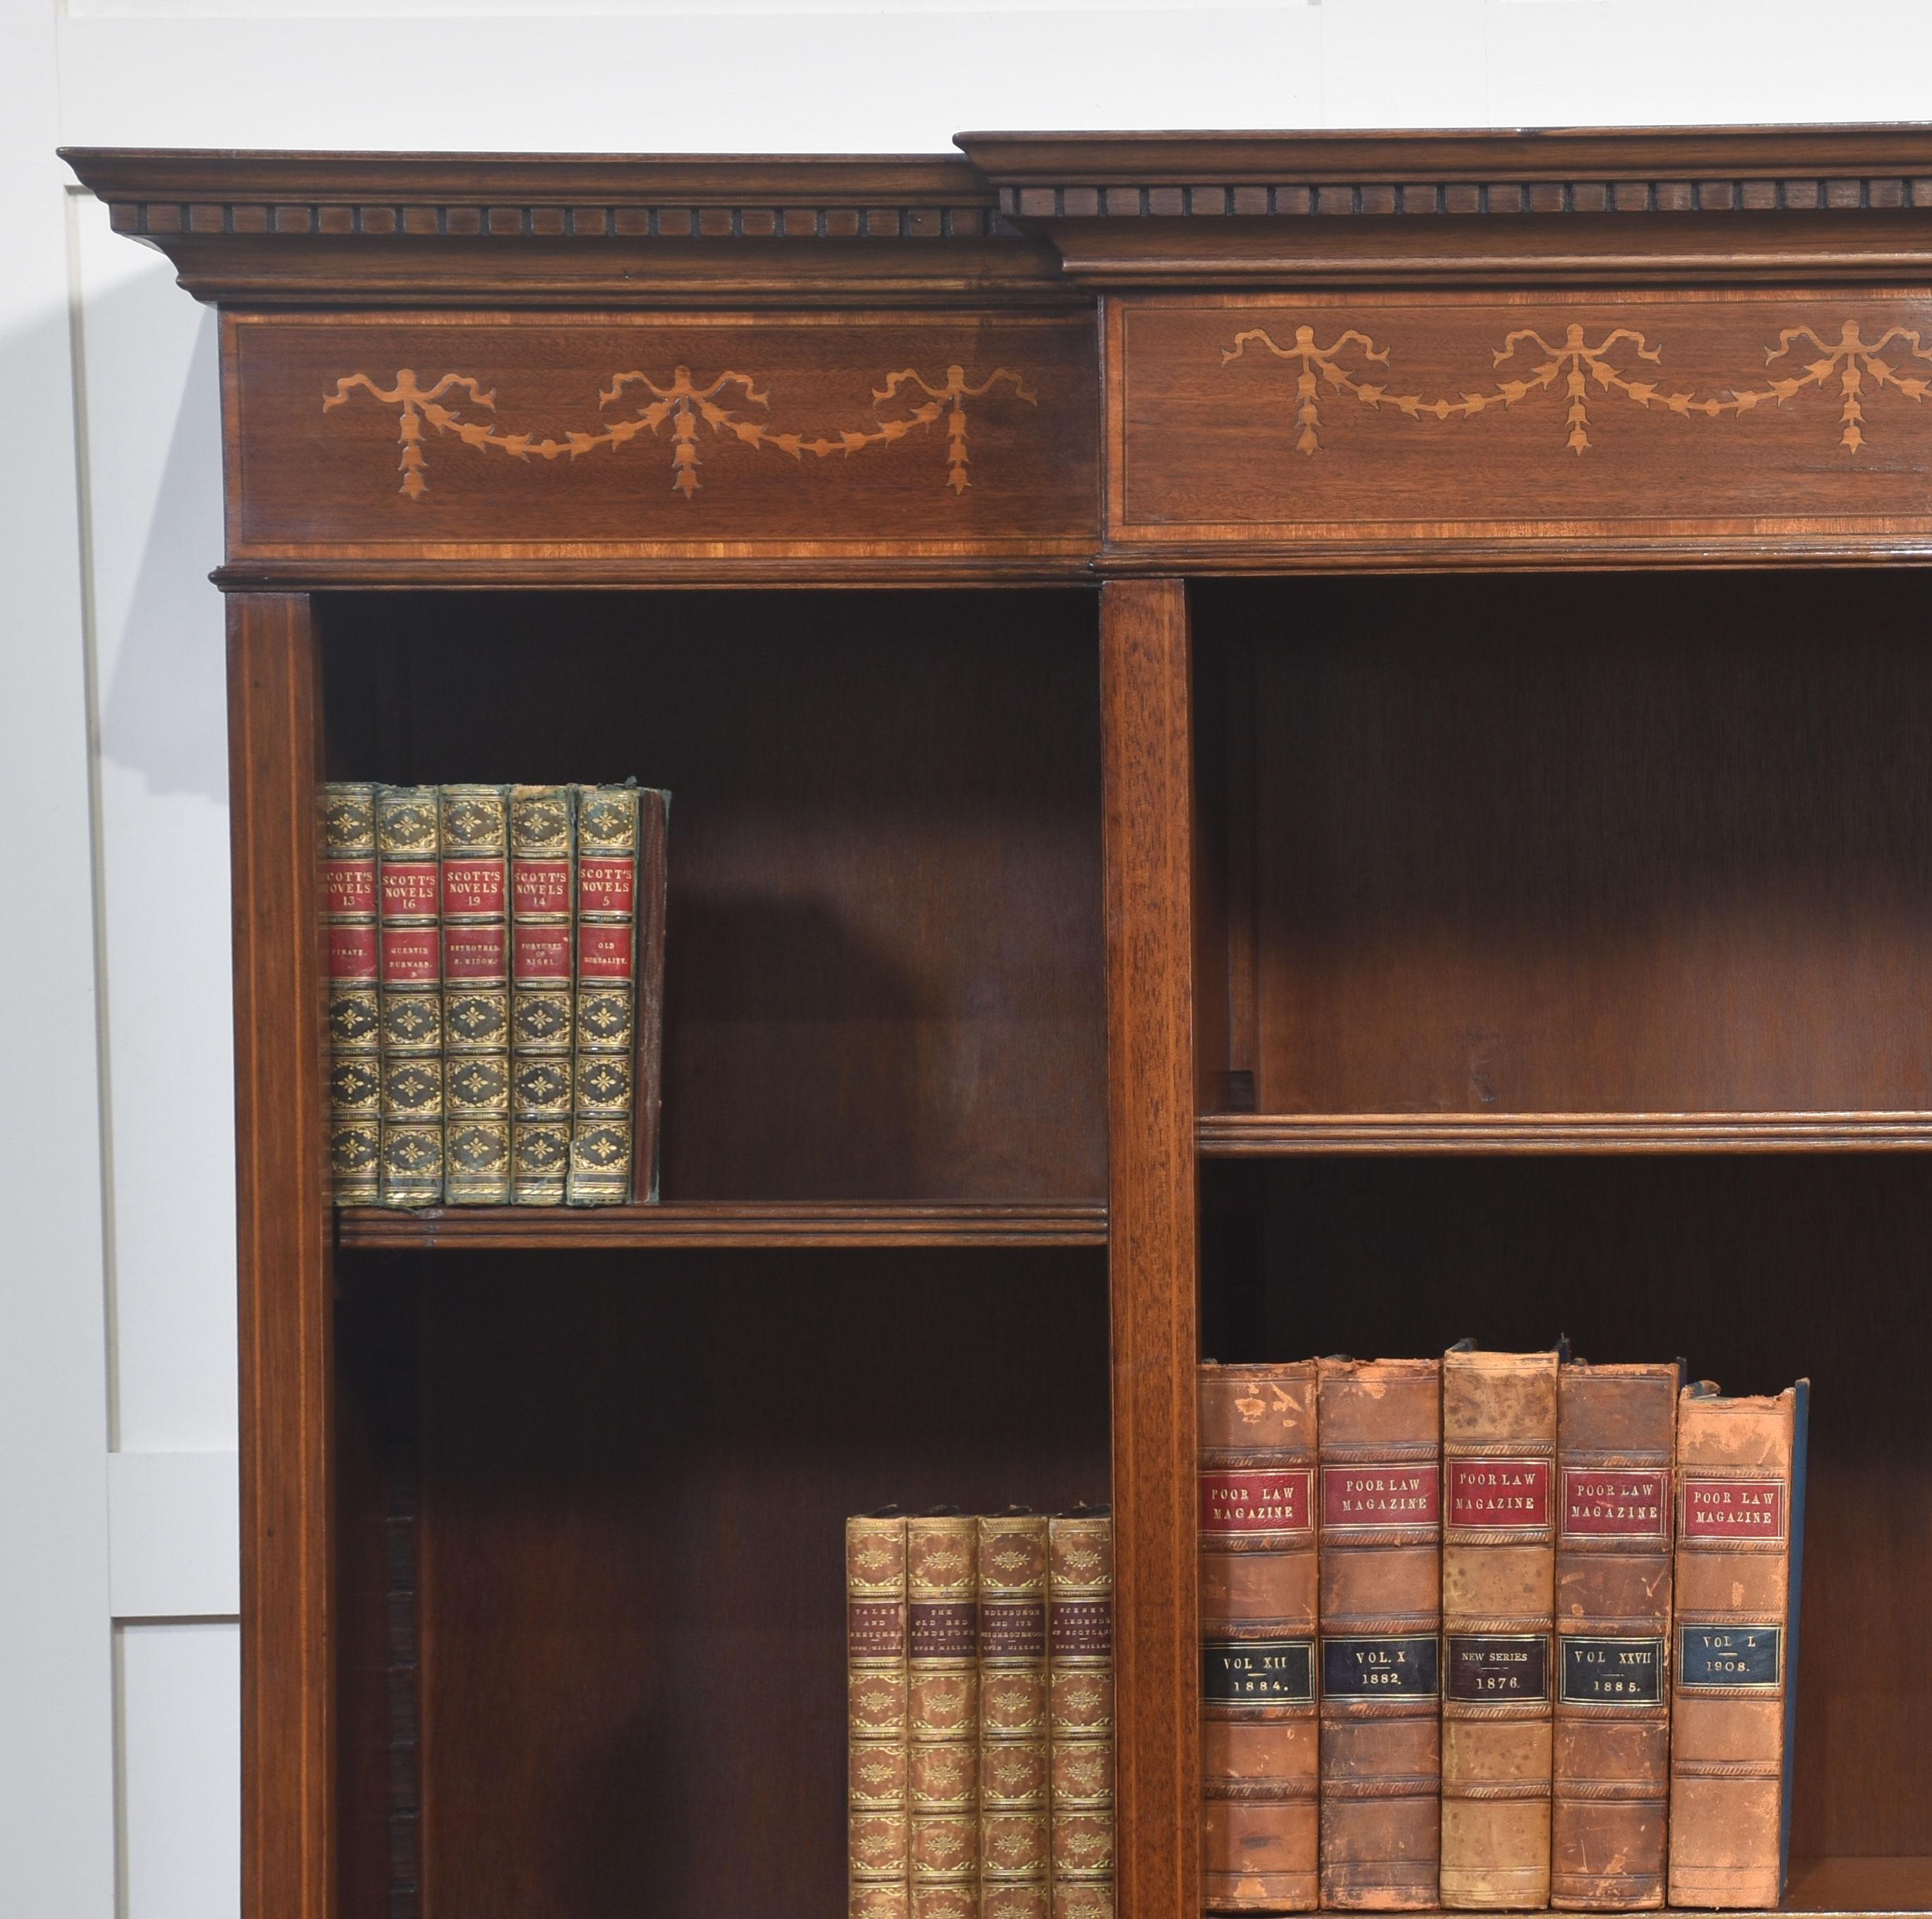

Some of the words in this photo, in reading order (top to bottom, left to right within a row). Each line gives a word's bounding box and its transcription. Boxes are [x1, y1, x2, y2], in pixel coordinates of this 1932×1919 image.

[327, 872, 373, 882] COTT'S
[448, 871, 501, 882] SCOTT'S
[515, 872, 567, 883] SCOTT'S
[580, 869, 632, 879] SCOTT'S
[383, 875, 436, 886] SCOTT'S
[330, 884, 371, 894] OVELS
[450, 883, 498, 894] NOVELS
[517, 884, 563, 895] NOVELS
[582, 882, 630, 892] NOVELS
[385, 888, 433, 898] NOVELS
[402, 899, 416, 909] 16
[468, 896, 481, 906] 19
[533, 897, 546, 907] 14
[602, 896, 610, 906] 5
[1459, 1473, 1496, 1486] POOR
[1501, 1474, 1536, 1486] LAW
[1345, 1480, 1385, 1492] POOR
[1388, 1479, 1421, 1491] LAW
[1576, 1485, 1616, 1497] POOR
[1621, 1484, 1653, 1496] LAW
[1211, 1489, 1249, 1500] POOR
[1262, 1487, 1295, 1499] LAW
[1693, 1491, 1732, 1504] POOR
[1741, 1492, 1775, 1505] LAW
[1342, 1498, 1427, 1512] MAGAZINE
[1455, 1497, 1535, 1510] MAGAZINE
[1213, 1506, 1294, 1520] MAGAZINE
[1571, 1505, 1658, 1520] MAGAZINE
[1696, 1510, 1772, 1524] MAGAZINE
[1703, 1635, 1732, 1648] VOL
[1747, 1636, 1756, 1647] L
[1355, 1652, 1392, 1664] VOL.
[1397, 1651, 1406, 1663] X
[1462, 1652, 1484, 1661] NEW
[1489, 1653, 1528, 1662] SERIES
[1574, 1651, 1606, 1664] VOL
[1618, 1652, 1652, 1665] XXVII
[1223, 1657, 1252, 1670] VOL
[1263, 1656, 1287, 1669] XII
[1706, 1661, 1751, 1673] 1908.
[1234, 1681, 1288, 1692] 1884.
